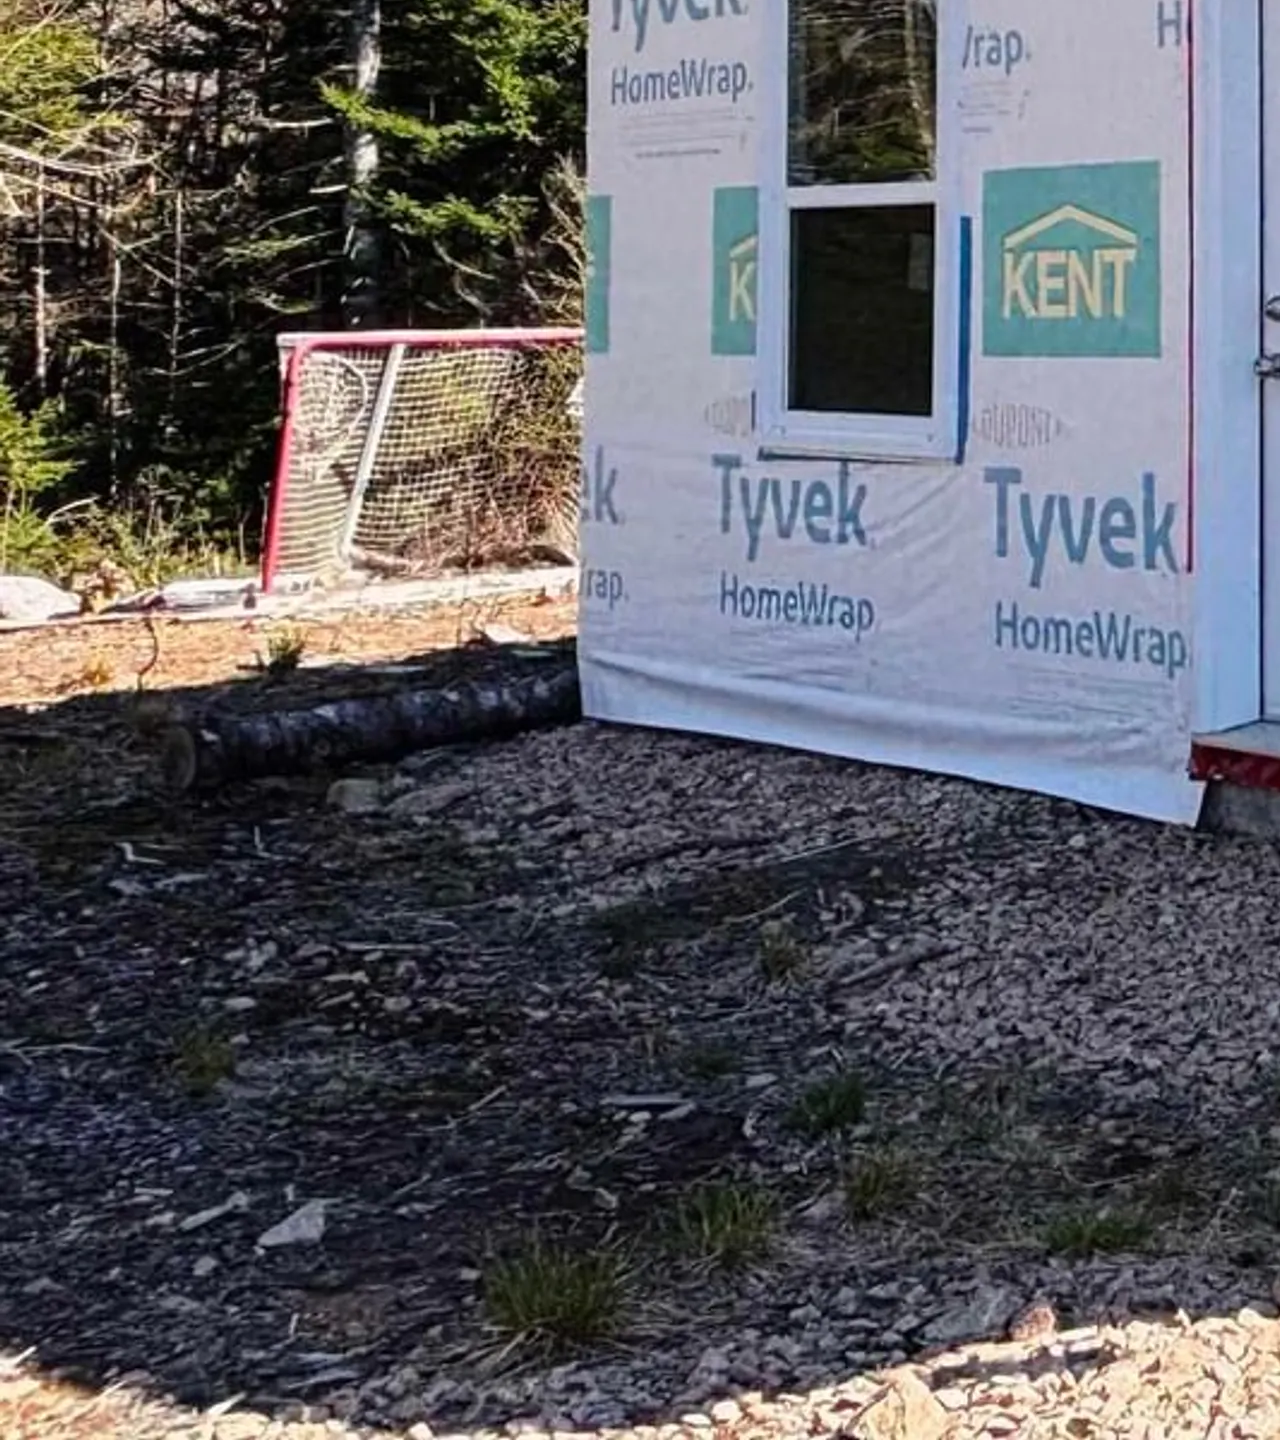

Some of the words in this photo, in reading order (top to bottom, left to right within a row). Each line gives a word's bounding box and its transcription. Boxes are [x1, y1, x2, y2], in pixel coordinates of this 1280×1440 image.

[611, 58, 748, 106] HomeWrap
[1003, 250, 1136, 320] KENT
[711, 454, 868, 562] Tyvek
[983, 468, 1179, 589] Tyvek
[720, 570, 875, 642] HomeWrap
[995, 600, 1187, 679] HomeWrap
